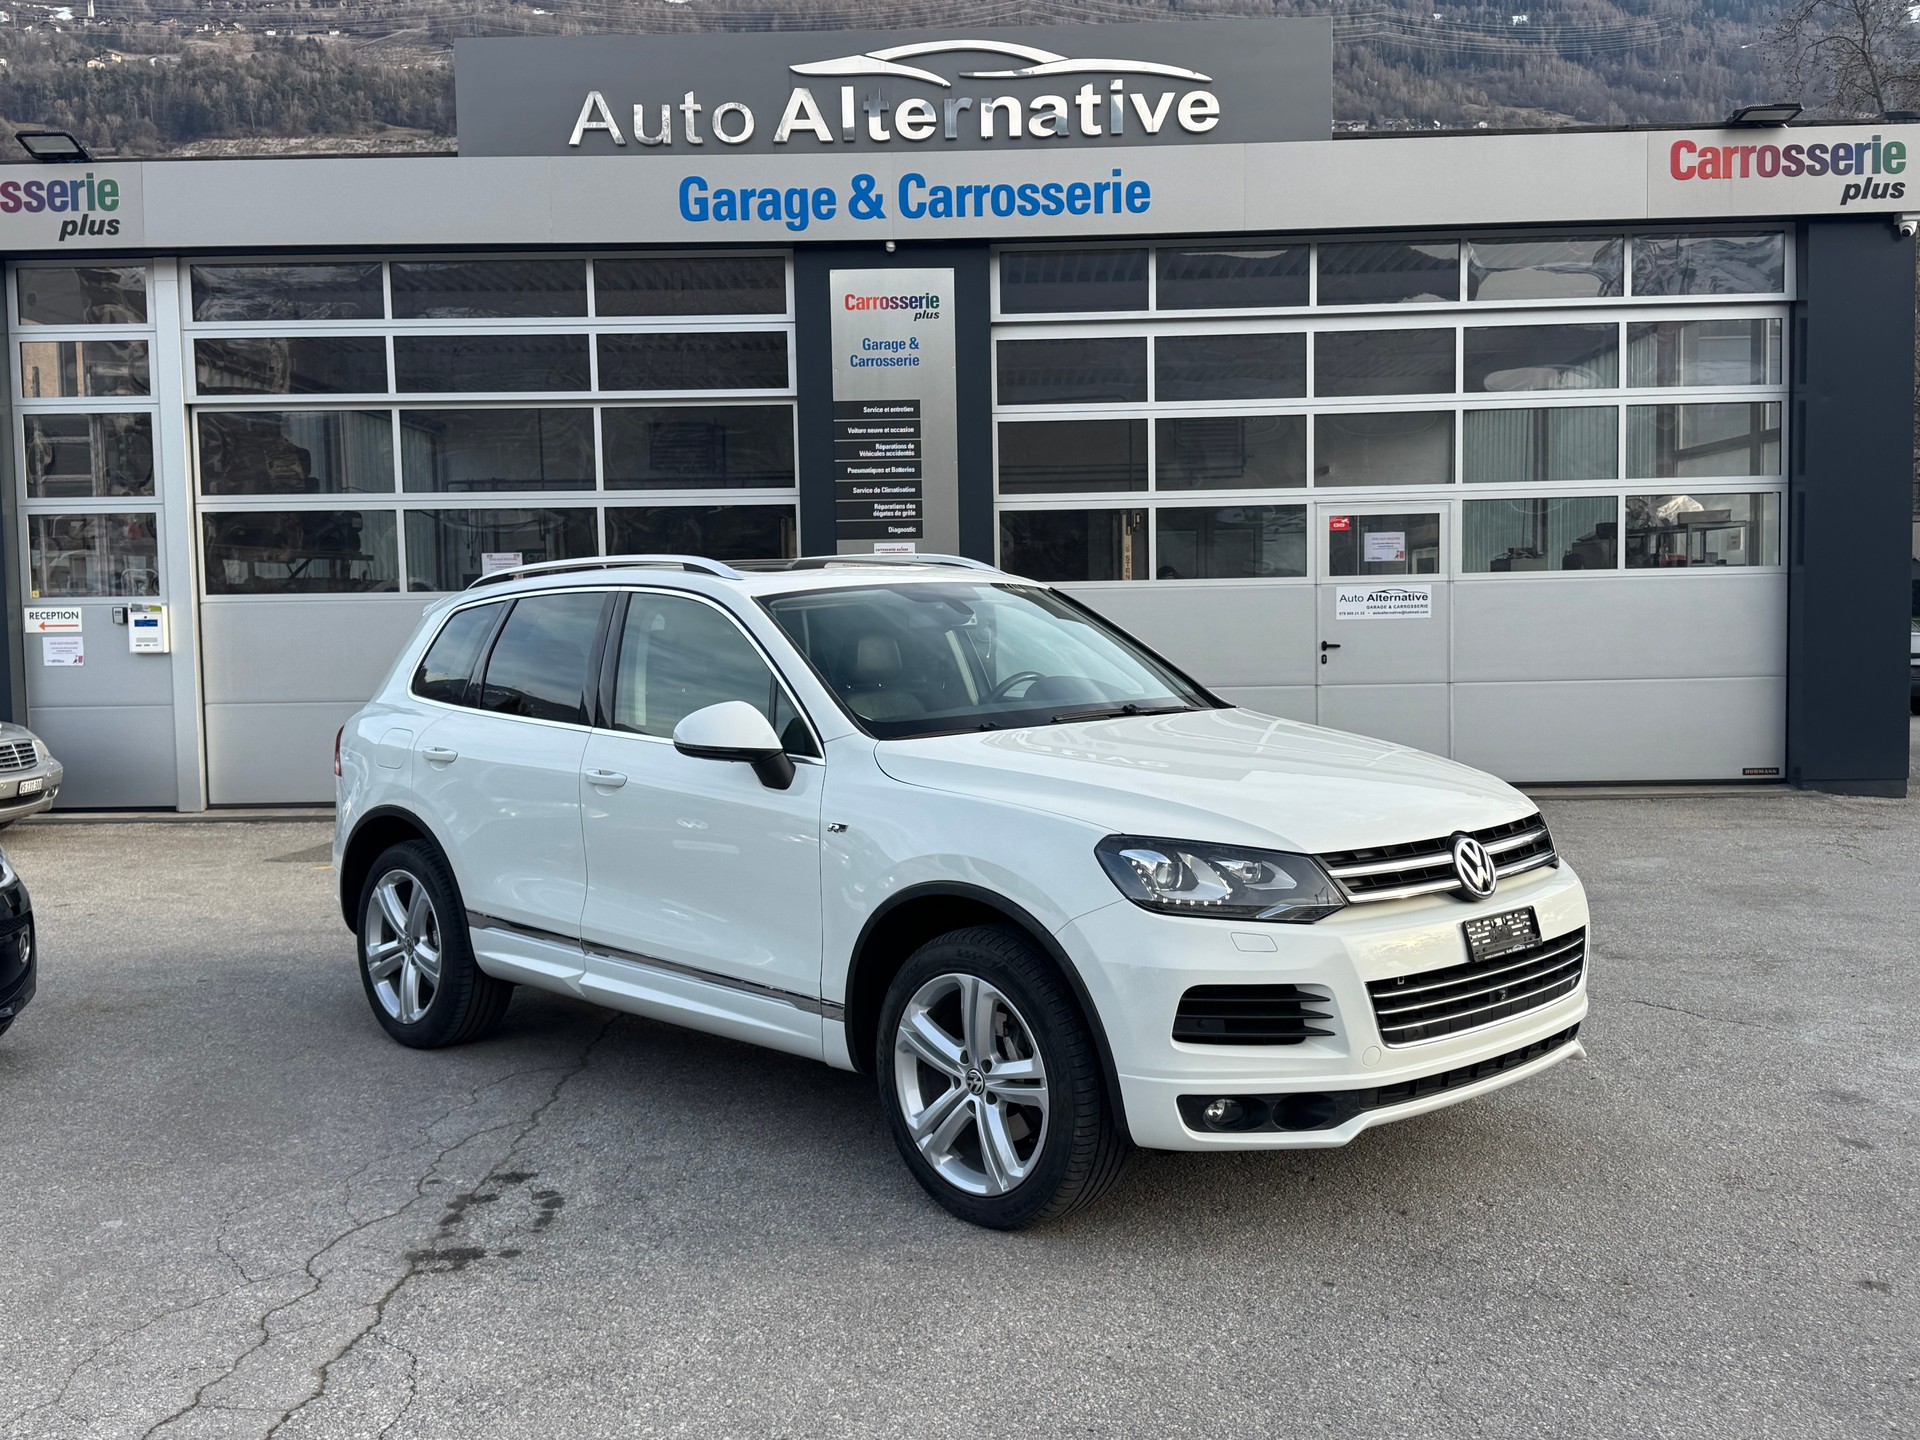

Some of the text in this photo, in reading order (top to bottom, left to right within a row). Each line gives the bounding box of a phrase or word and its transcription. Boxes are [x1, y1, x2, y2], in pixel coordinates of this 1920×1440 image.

[568, 79, 1221, 147] Auto Alternative
[1670, 135, 1906, 180] Carrosserie
[1840, 177, 1906, 206] plus
[679, 168, 1150, 231] Garage & Carrosserie
[58, 213, 120, 241] plus
[844, 292, 940, 310] Carrosserie
[913, 310, 940, 322] plus
[862, 336, 920, 353] Garage &
[850, 354, 920, 367] Carrosserie
[863, 406, 883, 414] Service
[859, 449, 885, 457] Véhicules
[875, 443, 907, 451] Réparations
[847, 467, 884, 475] Pneumatiques
[874, 503, 905, 511] Réparations
[888, 526, 916, 534] Diagnostic
[1339, 592, 1428, 603] Auto Alternative
[29, 611, 79, 620] RECEPTION
